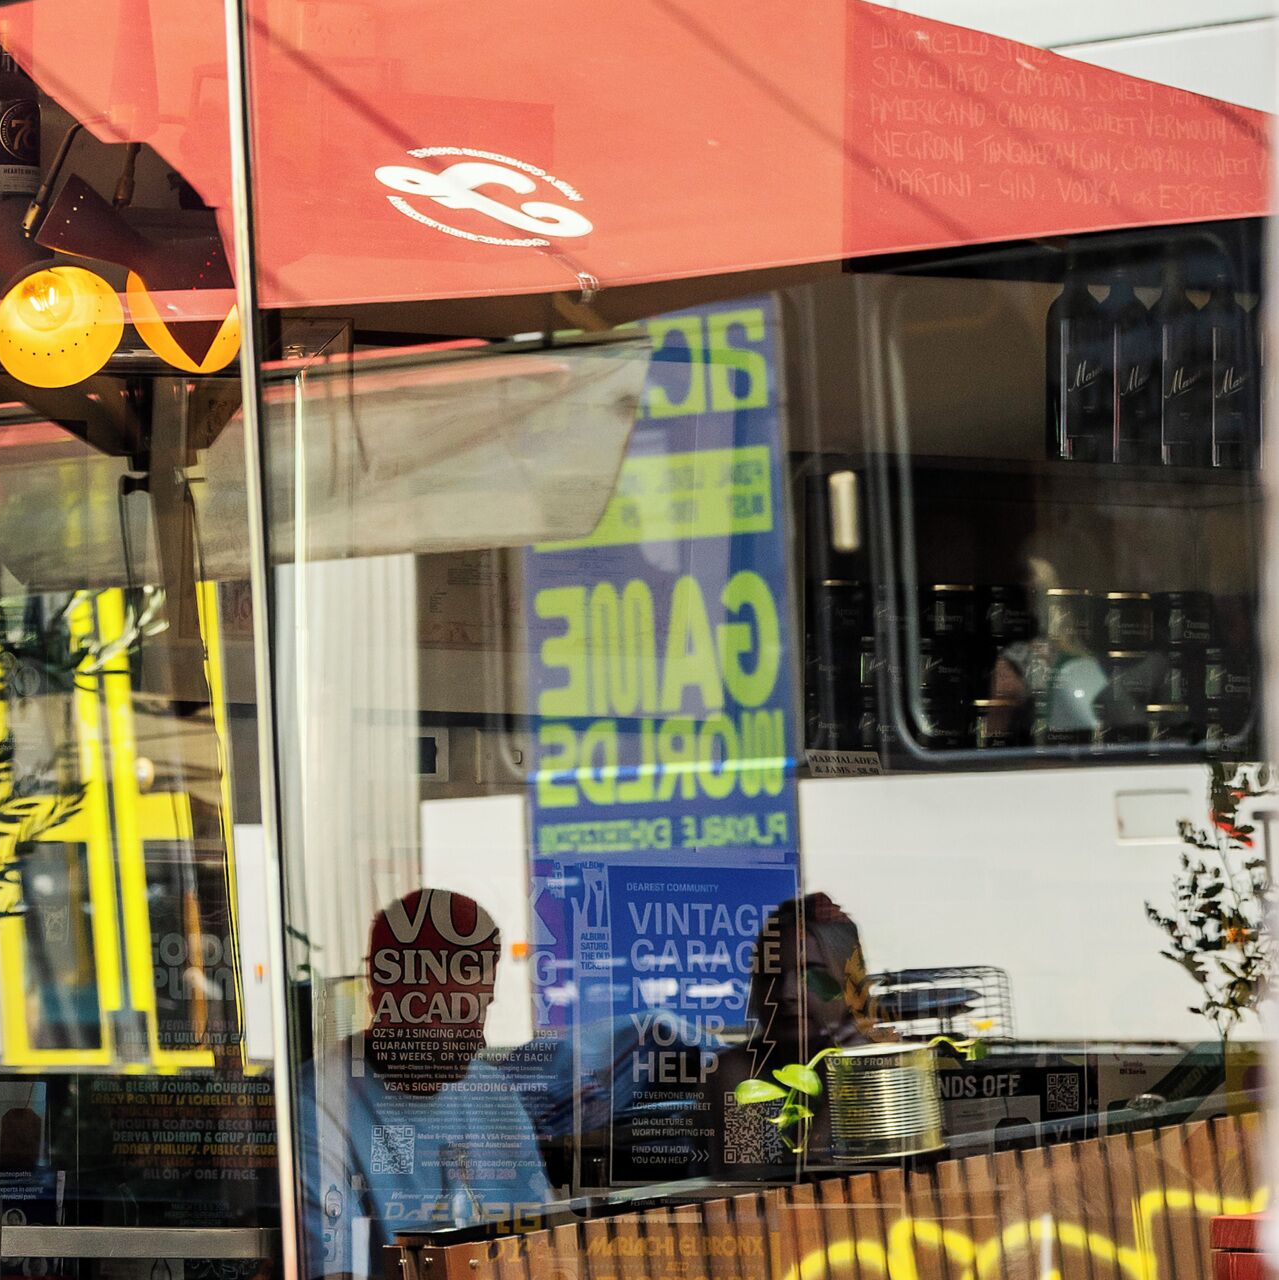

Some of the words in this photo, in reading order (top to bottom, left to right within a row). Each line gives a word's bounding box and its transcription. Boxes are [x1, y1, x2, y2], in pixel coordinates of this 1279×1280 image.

[874, 166, 973, 199] MARTINI
[809, 754, 879, 766] MARMALADES
[824, 766, 851, 775] JAMS
[626, 882, 664, 892] DEAREST
[666, 883, 720, 893] COMMUNITY
[626, 901, 781, 938] VINTAGE
[630, 939, 782, 975] GARAGE
[373, 948, 558, 987] SINGIG
[632, 976, 747, 1010] NEEDS
[373, 991, 554, 1025] ACADY
[372, 1028, 395, 1038] OZ'S
[412, 1028, 454, 1038] SINGING
[631, 1016, 726, 1047] YOUR
[372, 1041, 440, 1051] GUARANTEED
[442, 1041, 484, 1051] SINGING
[377, 1052, 389, 1061] IN
[391, 1052, 397, 1061] 3
[440, 1052, 455, 1061] OR
[457, 1052, 483, 1061] YOUR
[486, 1052, 522, 1062] MONEY
[524, 1052, 553, 1062] BACK!
[632, 1050, 720, 1084] HELP
[411, 1082, 448, 1092] SIGNED
[450, 1082, 508, 1092] RECORDING
[510, 1082, 548, 1092] ARTISTS
[982, 1074, 1021, 1097] OFF
[632, 1091, 643, 1099] TO
[644, 1091, 685, 1100] EVERYONE
[685, 1092, 705, 1100] WHO
[684, 1102, 711, 1111] STREET
[632, 1118, 649, 1126] OUR
[649, 1118, 685, 1126] CULTURE
[686, 1118, 693, 1126] IS
[631, 1129, 661, 1137] WORTH
[662, 1128, 698, 1137] FIGHTING
[699, 1129, 716, 1137] FOR
[202, 1144, 240, 1155] PUBLIC
[631, 1145, 652, 1154] FIND
[652, 1145, 669, 1154] OUT
[669, 1146, 690, 1154] HOW
[631, 1156, 649, 1164] YOU
[649, 1156, 667, 1164] CAN
[668, 1156, 688, 1164] HELP
